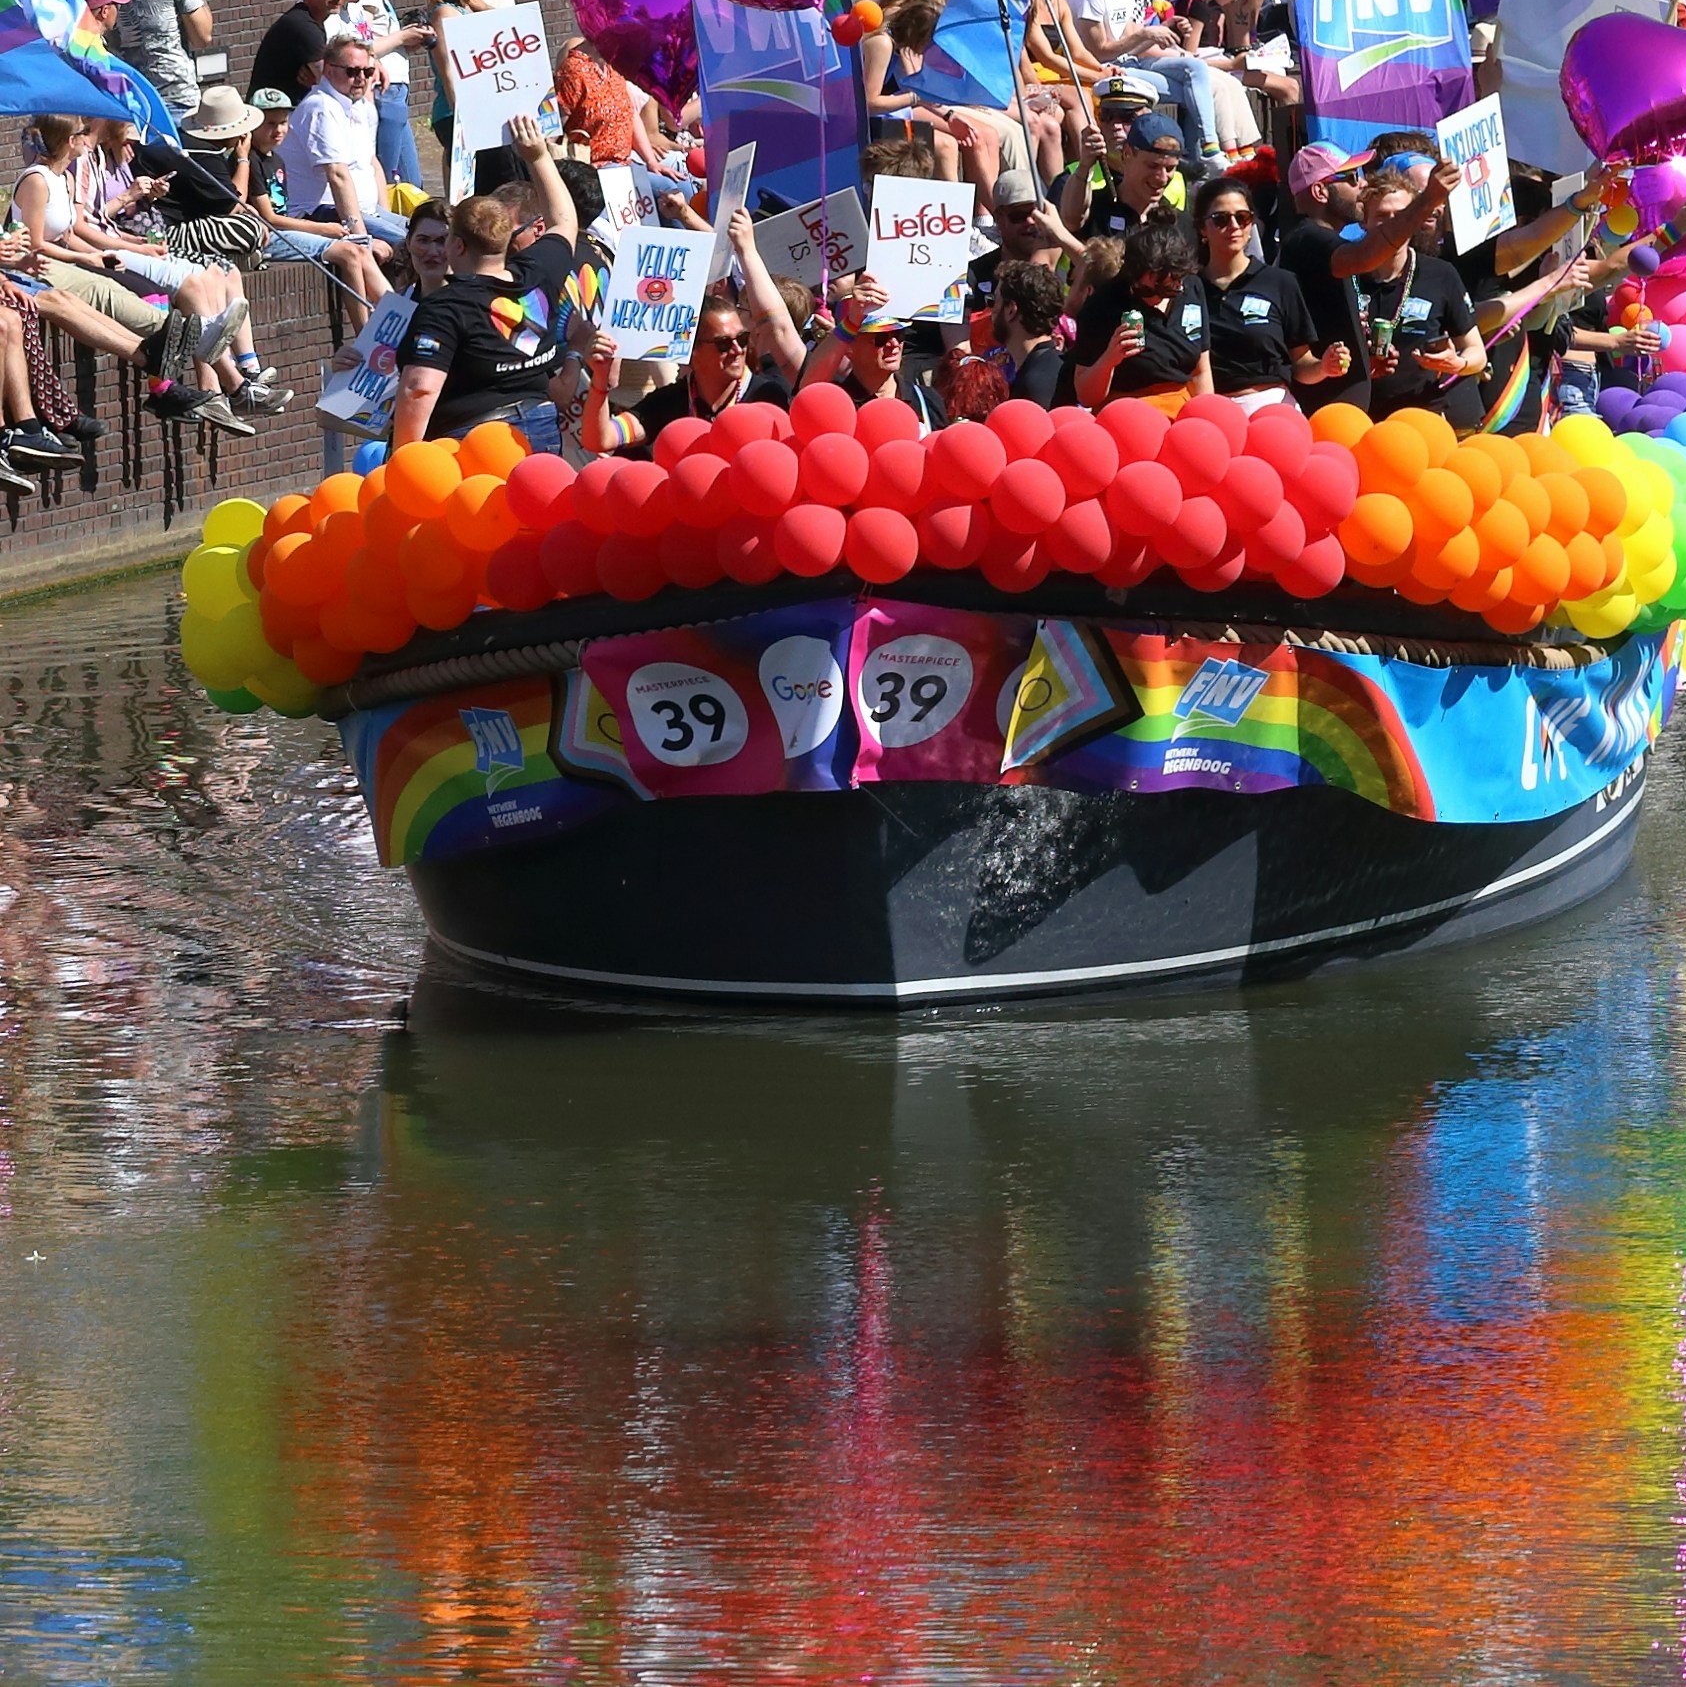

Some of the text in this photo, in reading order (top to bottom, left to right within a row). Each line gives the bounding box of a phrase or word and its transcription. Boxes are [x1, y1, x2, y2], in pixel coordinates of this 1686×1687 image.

[450, 26, 542, 80] Liefde
[608, 186, 655, 232] Liefde
[874, 202, 966, 241] Liefde
[636, 243, 691, 281] VEILIGE
[666, 341, 690, 357] FNV
[878, 652, 962, 667] MASTERPIECE
[635, 675, 712, 695] MASTERPIECE
[870, 671, 948, 723] 39
[1180, 671, 1265, 709] FNV
[468, 715, 518, 758] FNV
[650, 693, 726, 752] 39
